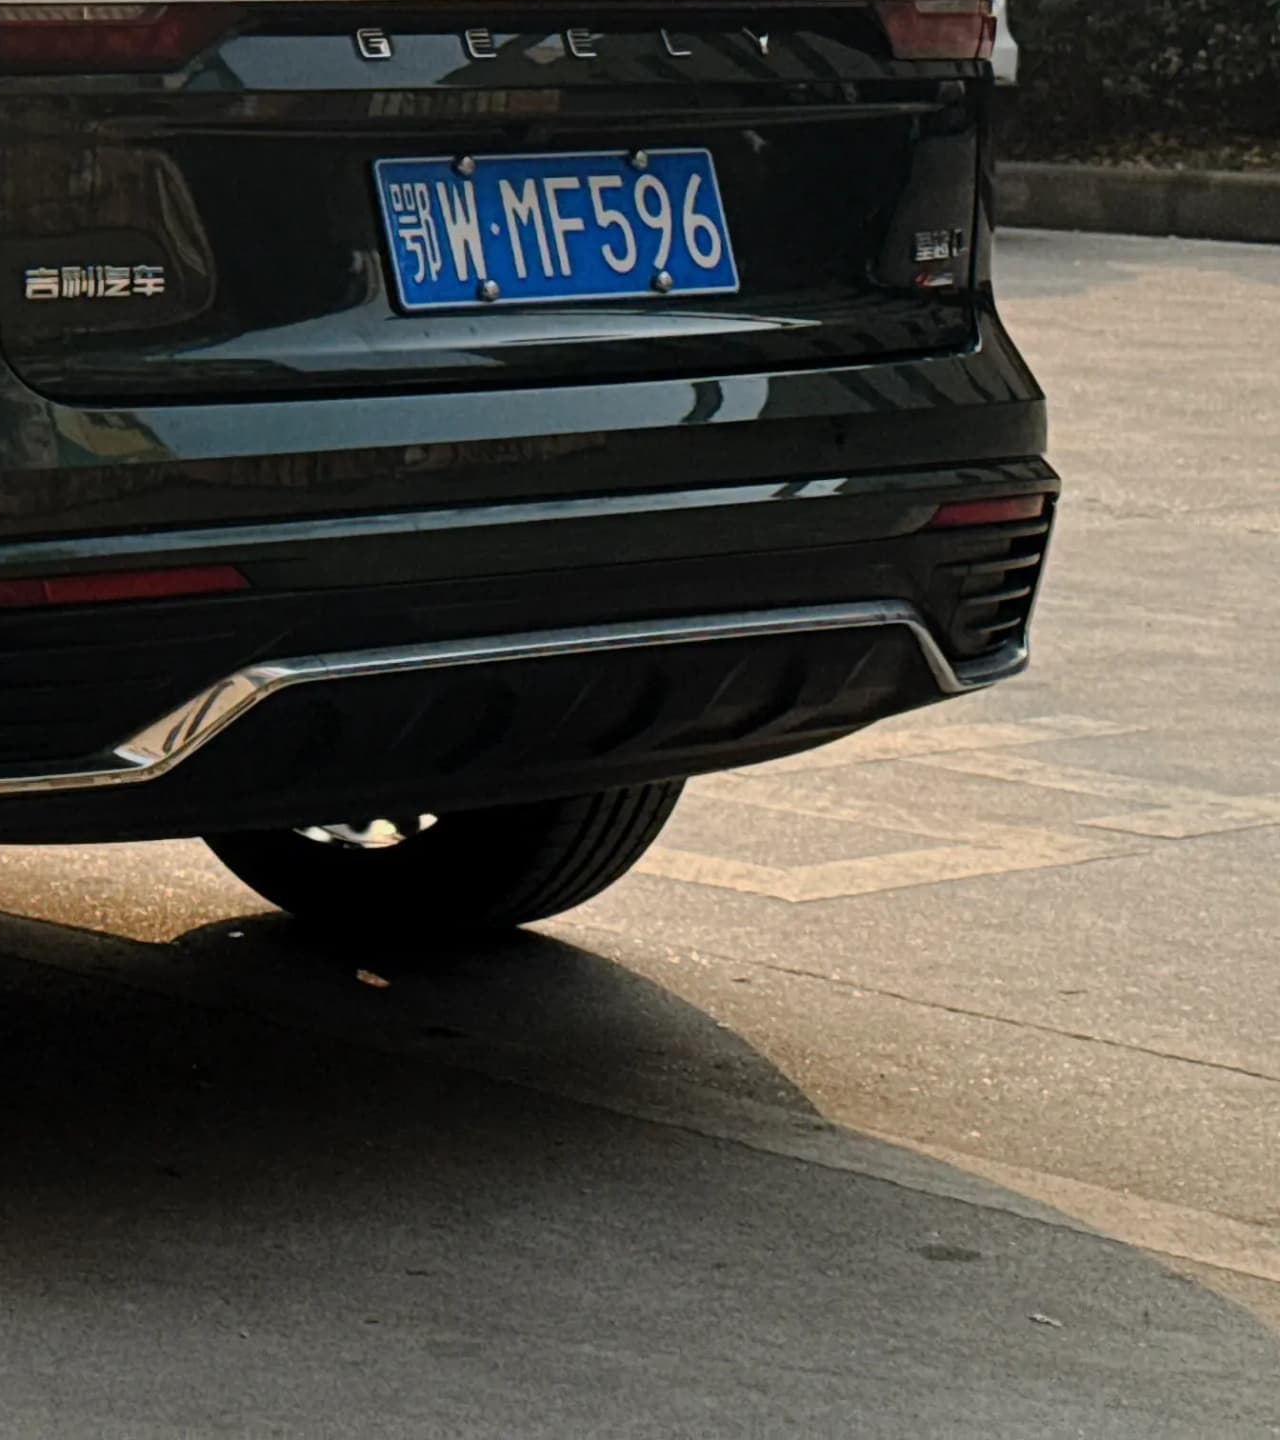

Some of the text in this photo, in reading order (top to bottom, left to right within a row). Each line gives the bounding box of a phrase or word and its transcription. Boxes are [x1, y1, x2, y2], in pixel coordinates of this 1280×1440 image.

[355, 27, 770, 58] GEELY
[25, 265, 165, 299] 吉利汽车
